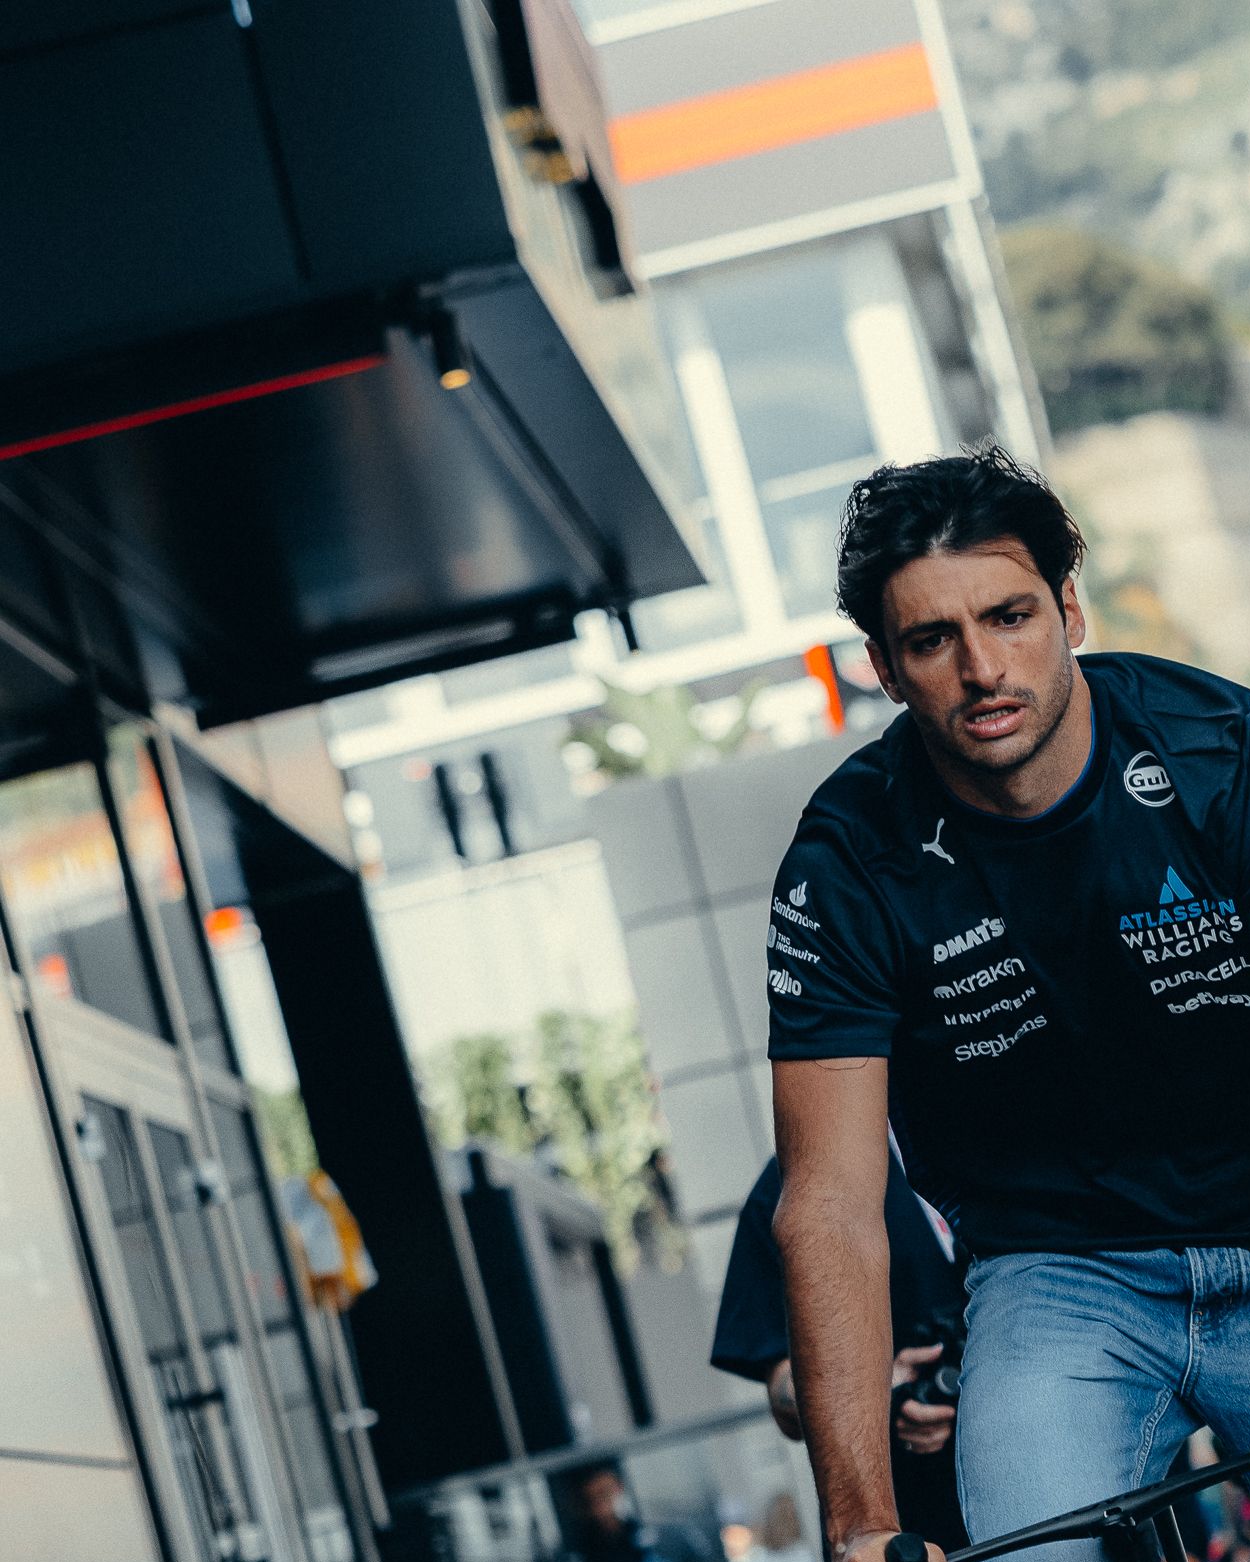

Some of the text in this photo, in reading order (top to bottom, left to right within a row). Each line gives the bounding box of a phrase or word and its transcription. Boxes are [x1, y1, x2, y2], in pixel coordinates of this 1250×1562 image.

[772, 896, 821, 932] Santander
[1119, 898, 1236, 931] ATLASSIN
[777, 932, 792, 946] THG
[933, 917, 1007, 965] OMATS
[1142, 928, 1234, 964] RACING
[959, 986, 1037, 1025] MYPROEIN
[954, 1014, 1048, 1062] Stephens
